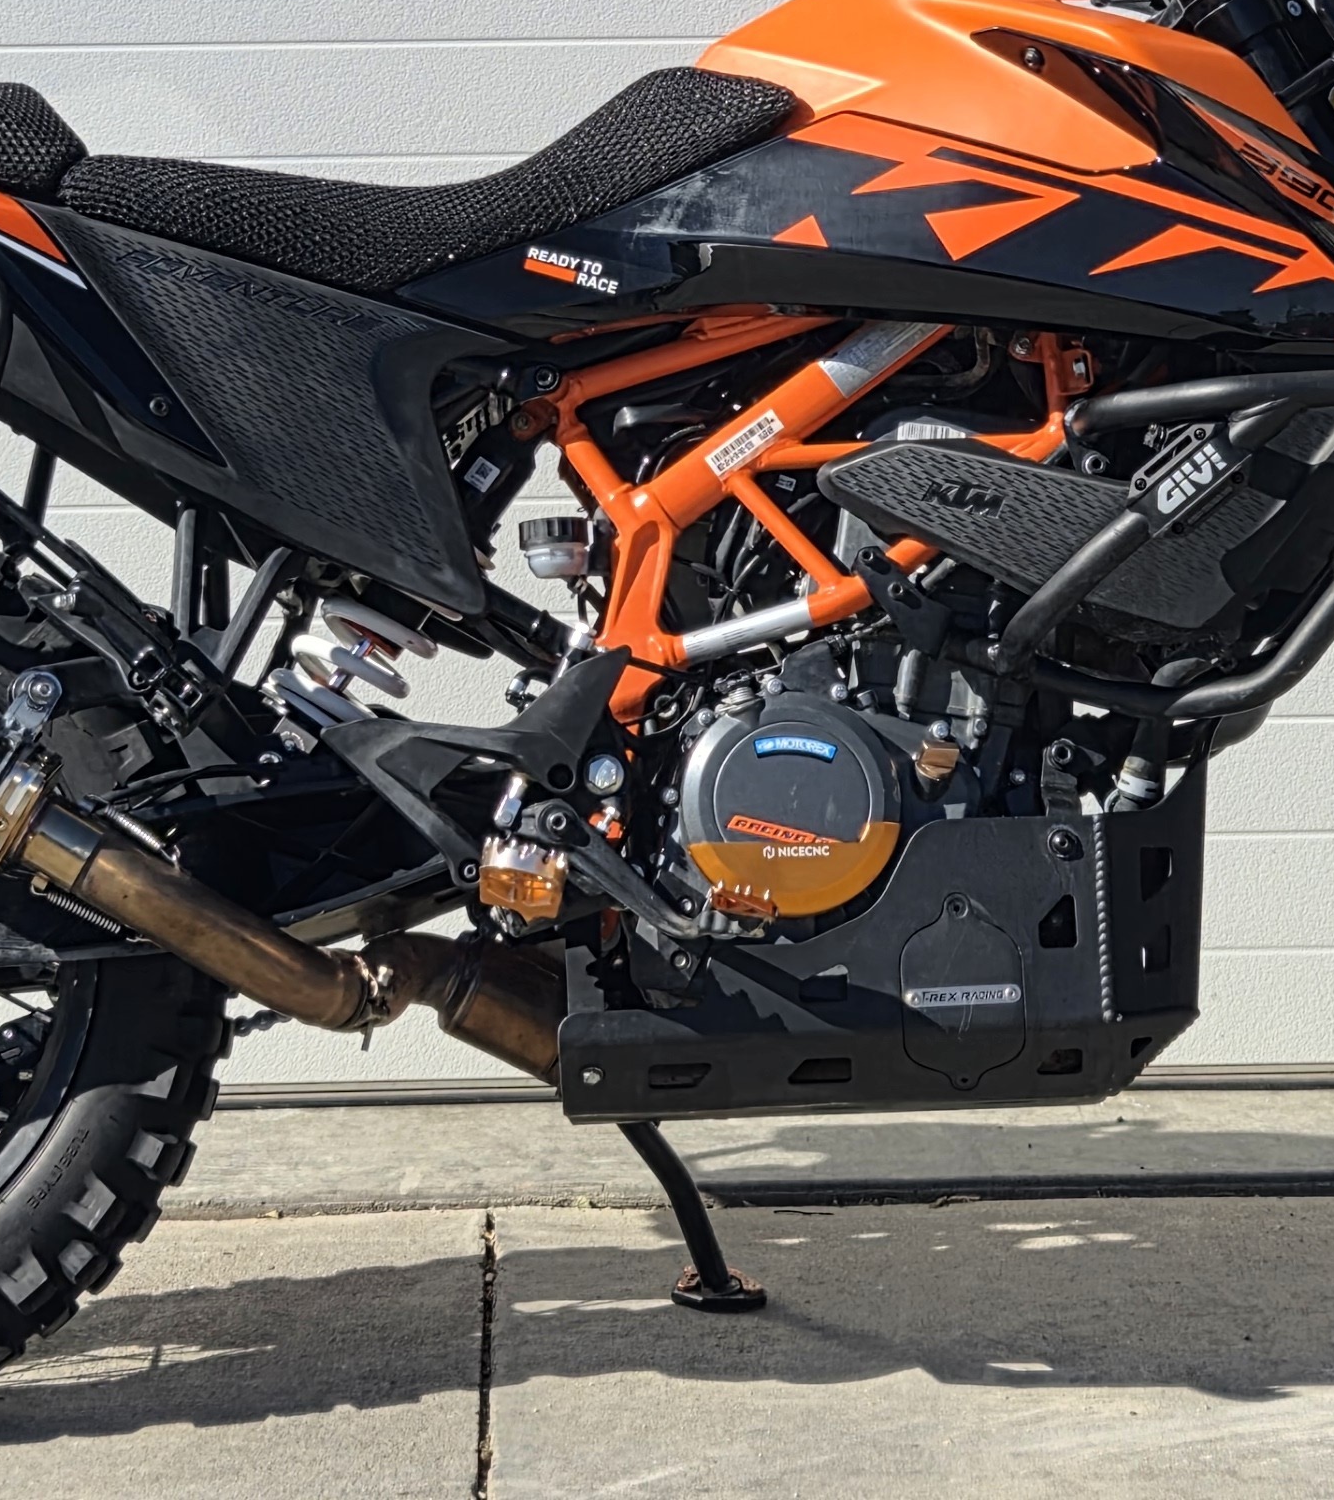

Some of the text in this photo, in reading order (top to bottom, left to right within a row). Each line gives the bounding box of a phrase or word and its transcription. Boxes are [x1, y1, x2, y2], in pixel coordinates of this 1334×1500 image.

[528, 248, 603, 276] READY TO
[576, 272, 619, 295] RACE
[1157, 443, 1228, 515] GIVI
[920, 480, 1008, 519] KTM
[775, 737, 831, 758] MOTOREX
[778, 845, 830, 858] NICECNC
[921, 989, 1005, 1003] T-REX RACING
